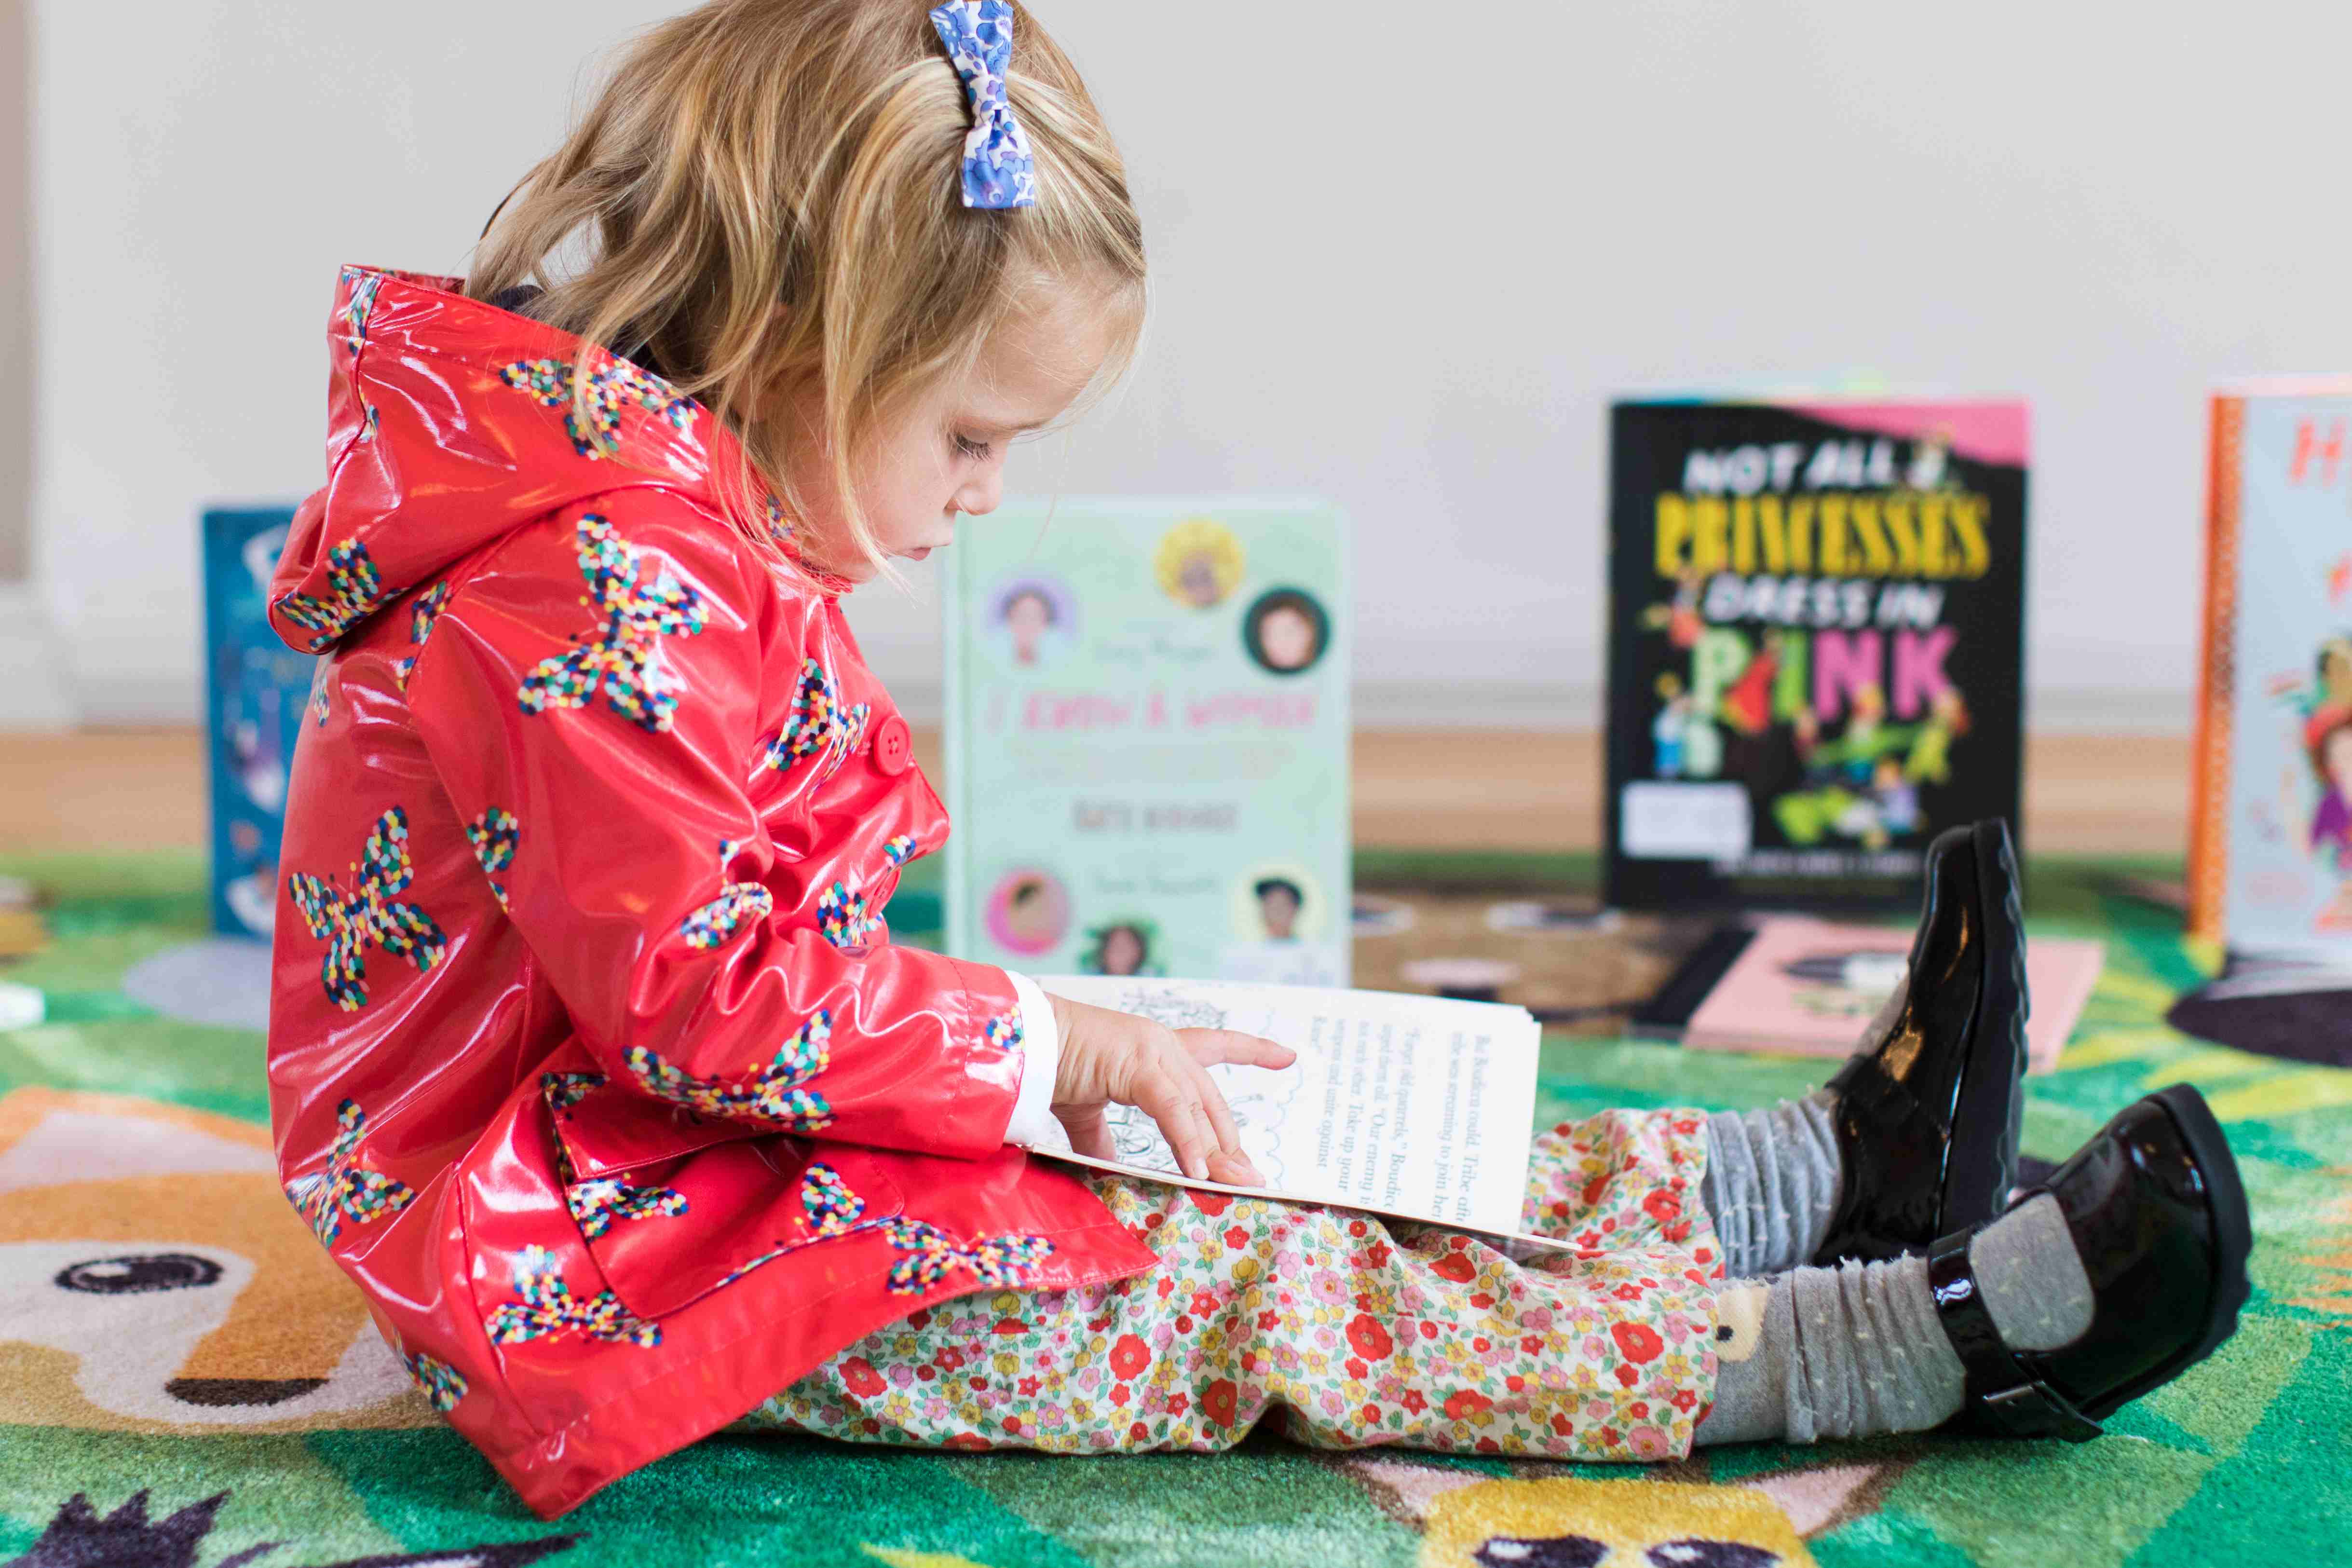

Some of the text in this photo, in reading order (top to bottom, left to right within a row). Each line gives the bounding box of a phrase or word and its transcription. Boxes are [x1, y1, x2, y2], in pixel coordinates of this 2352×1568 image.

[1682, 440, 1894, 494] NOT ALL
[1655, 491, 1990, 580] PRINCESSES
[1702, 572, 1946, 628] DRESS IN
[1690, 626, 1957, 722] PINK
[1327, 1064, 1343, 1084] and
[1400, 1069, 1414, 1086] old
[1449, 1059, 1460, 1078] was
[1324, 1088, 1339, 1117] unite
[1346, 1103, 1364, 1133] Take
[1439, 1082, 1460, 1141] streaming
[1317, 1120, 1333, 1167] against
[1342, 1137, 1356, 1152] up
[1465, 1111, 1482, 1148] could.
[1359, 1144, 1380, 1192] enemy
[1439, 1145, 1452, 1159] to
[1337, 1158, 1354, 1192] your
[1434, 1160, 1453, 1189] join
[1458, 1155, 1479, 1192] Tribe
